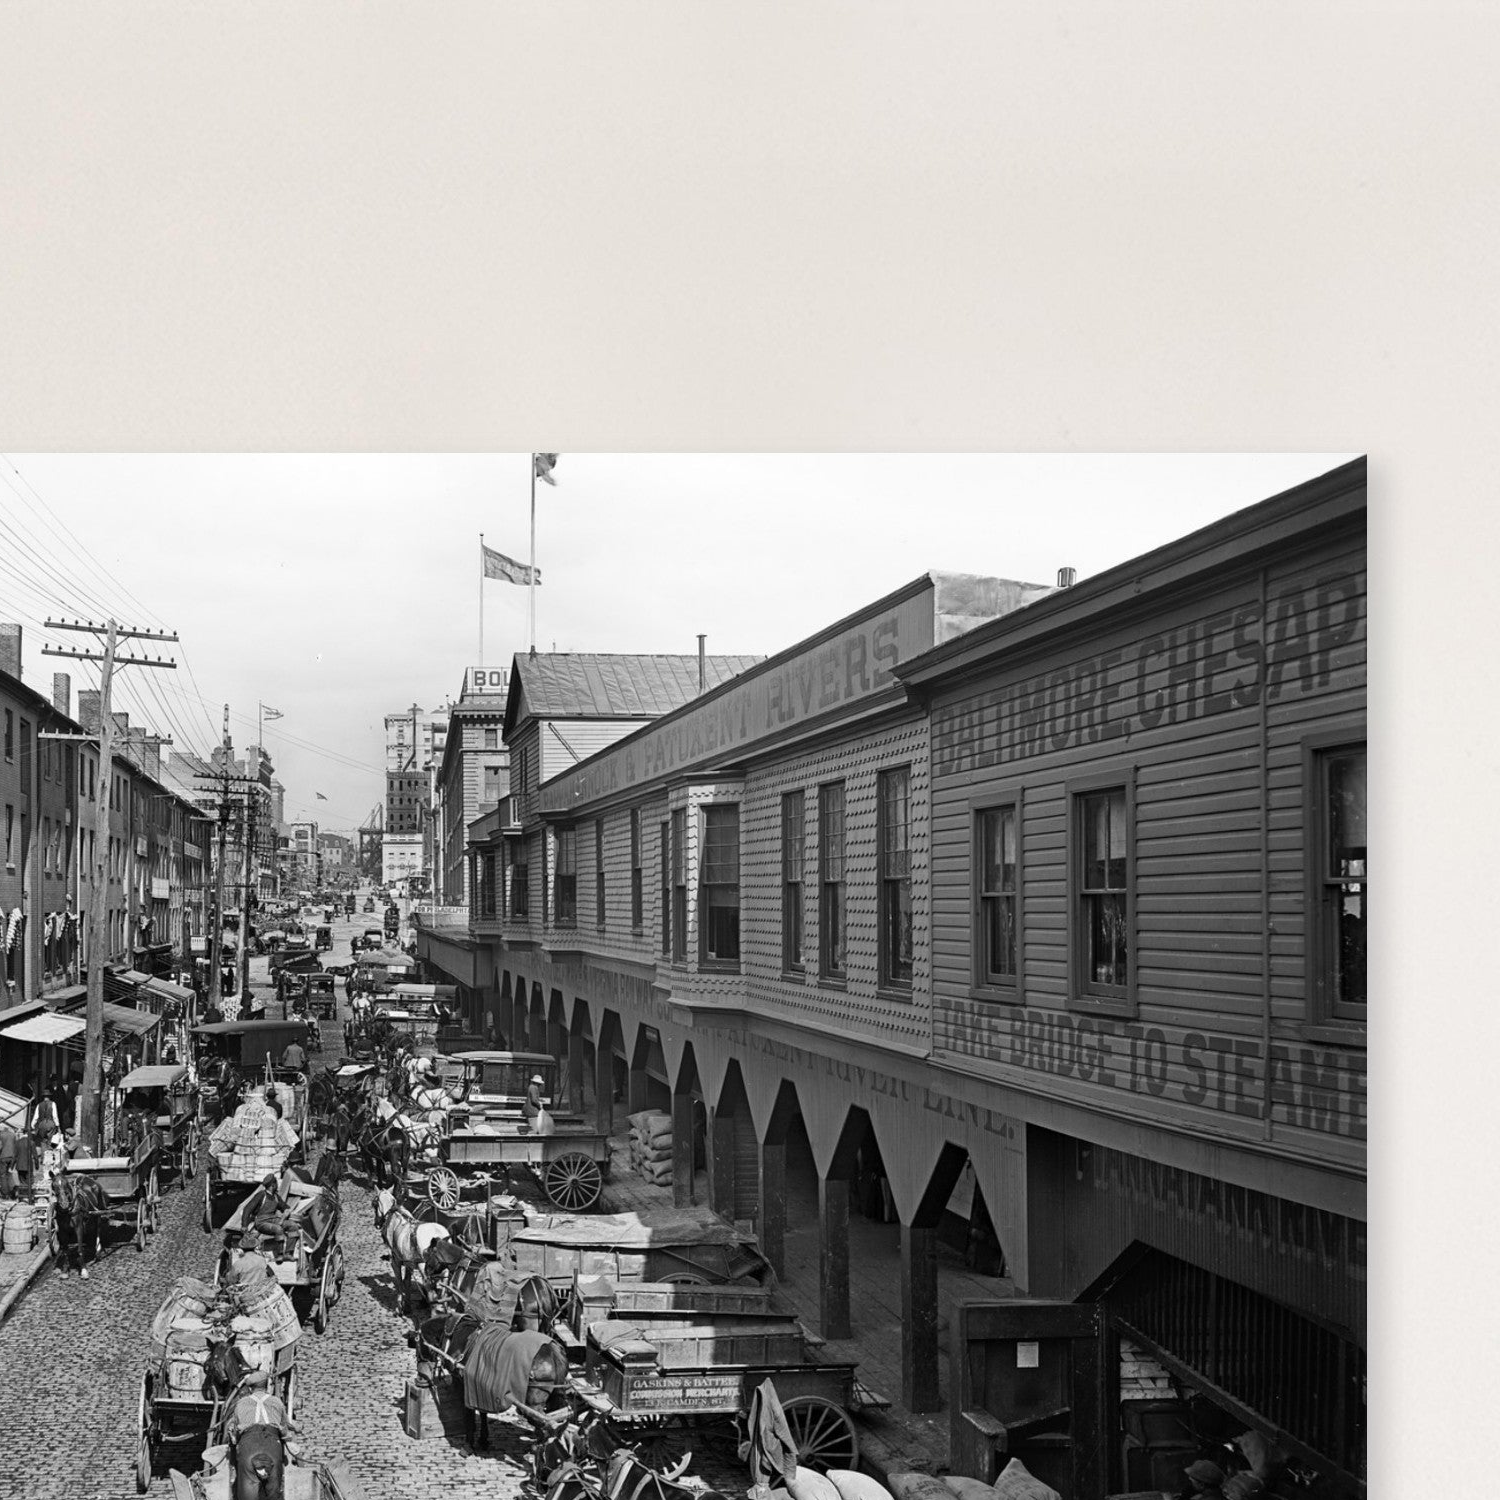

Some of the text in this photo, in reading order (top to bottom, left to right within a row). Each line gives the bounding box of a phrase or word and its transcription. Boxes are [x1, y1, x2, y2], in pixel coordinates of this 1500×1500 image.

[474, 670, 509, 686] BOL
[766, 616, 899, 729] RIVERS
[1137, 571, 1360, 729] CHESAP
[939, 998, 1000, 1059] TAKE
[1010, 1008, 1116, 1087] BRIDGE
[1128, 1026, 1169, 1097] TO
[629, 1388, 683, 1400] COMMISSION
[633, 1379, 682, 1389] GASKINS
[684, 1379, 692, 1387] &
